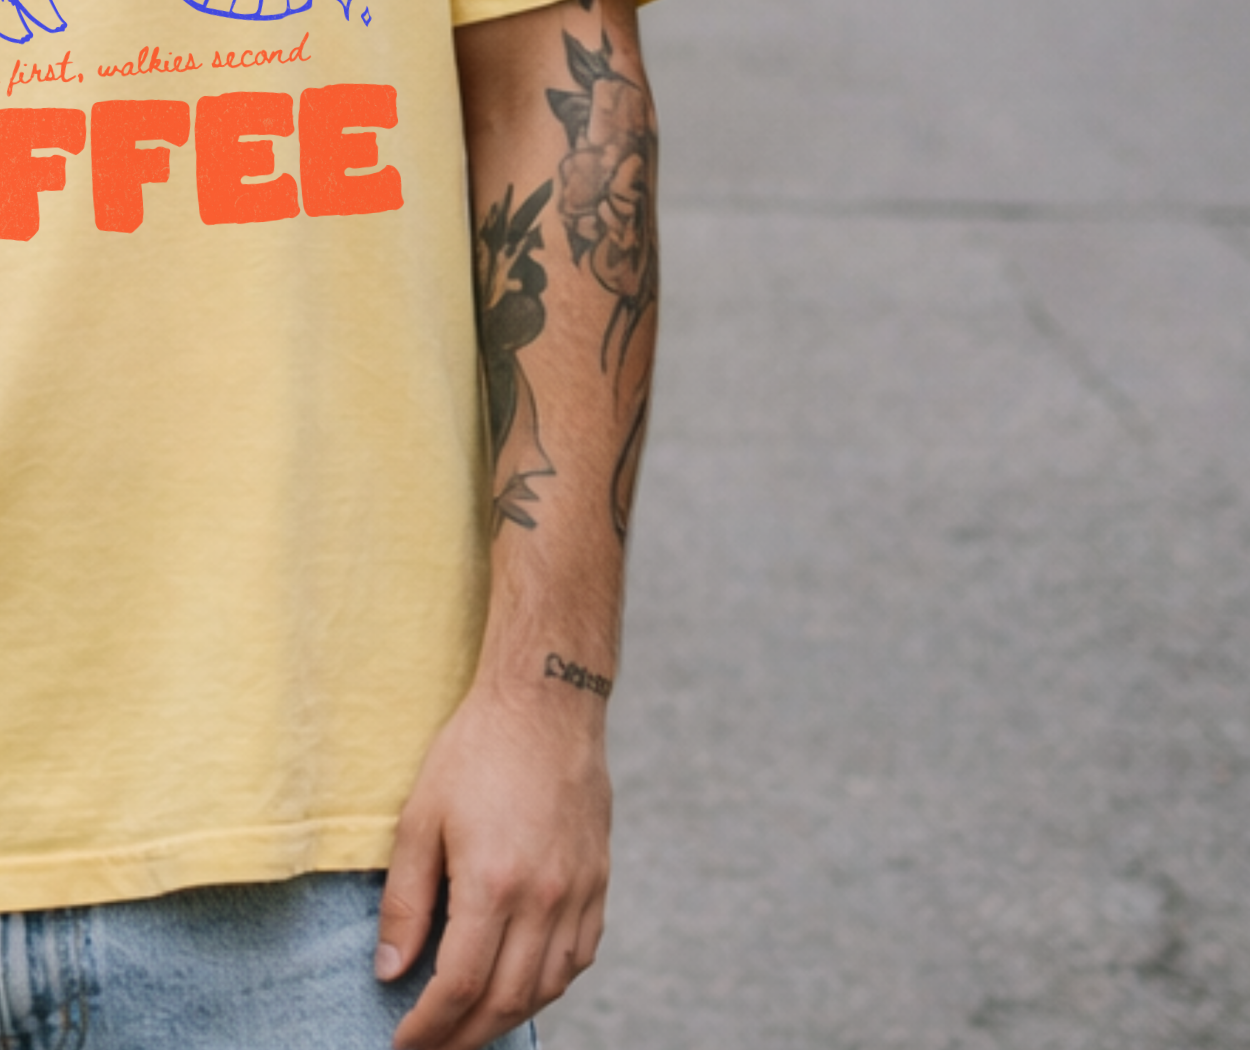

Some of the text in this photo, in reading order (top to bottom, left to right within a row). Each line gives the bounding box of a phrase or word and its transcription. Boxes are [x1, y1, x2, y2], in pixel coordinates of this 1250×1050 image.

[6, 50, 85, 97] first,
[97, 45, 203, 77] walkies
[211, 31, 312, 69] second
